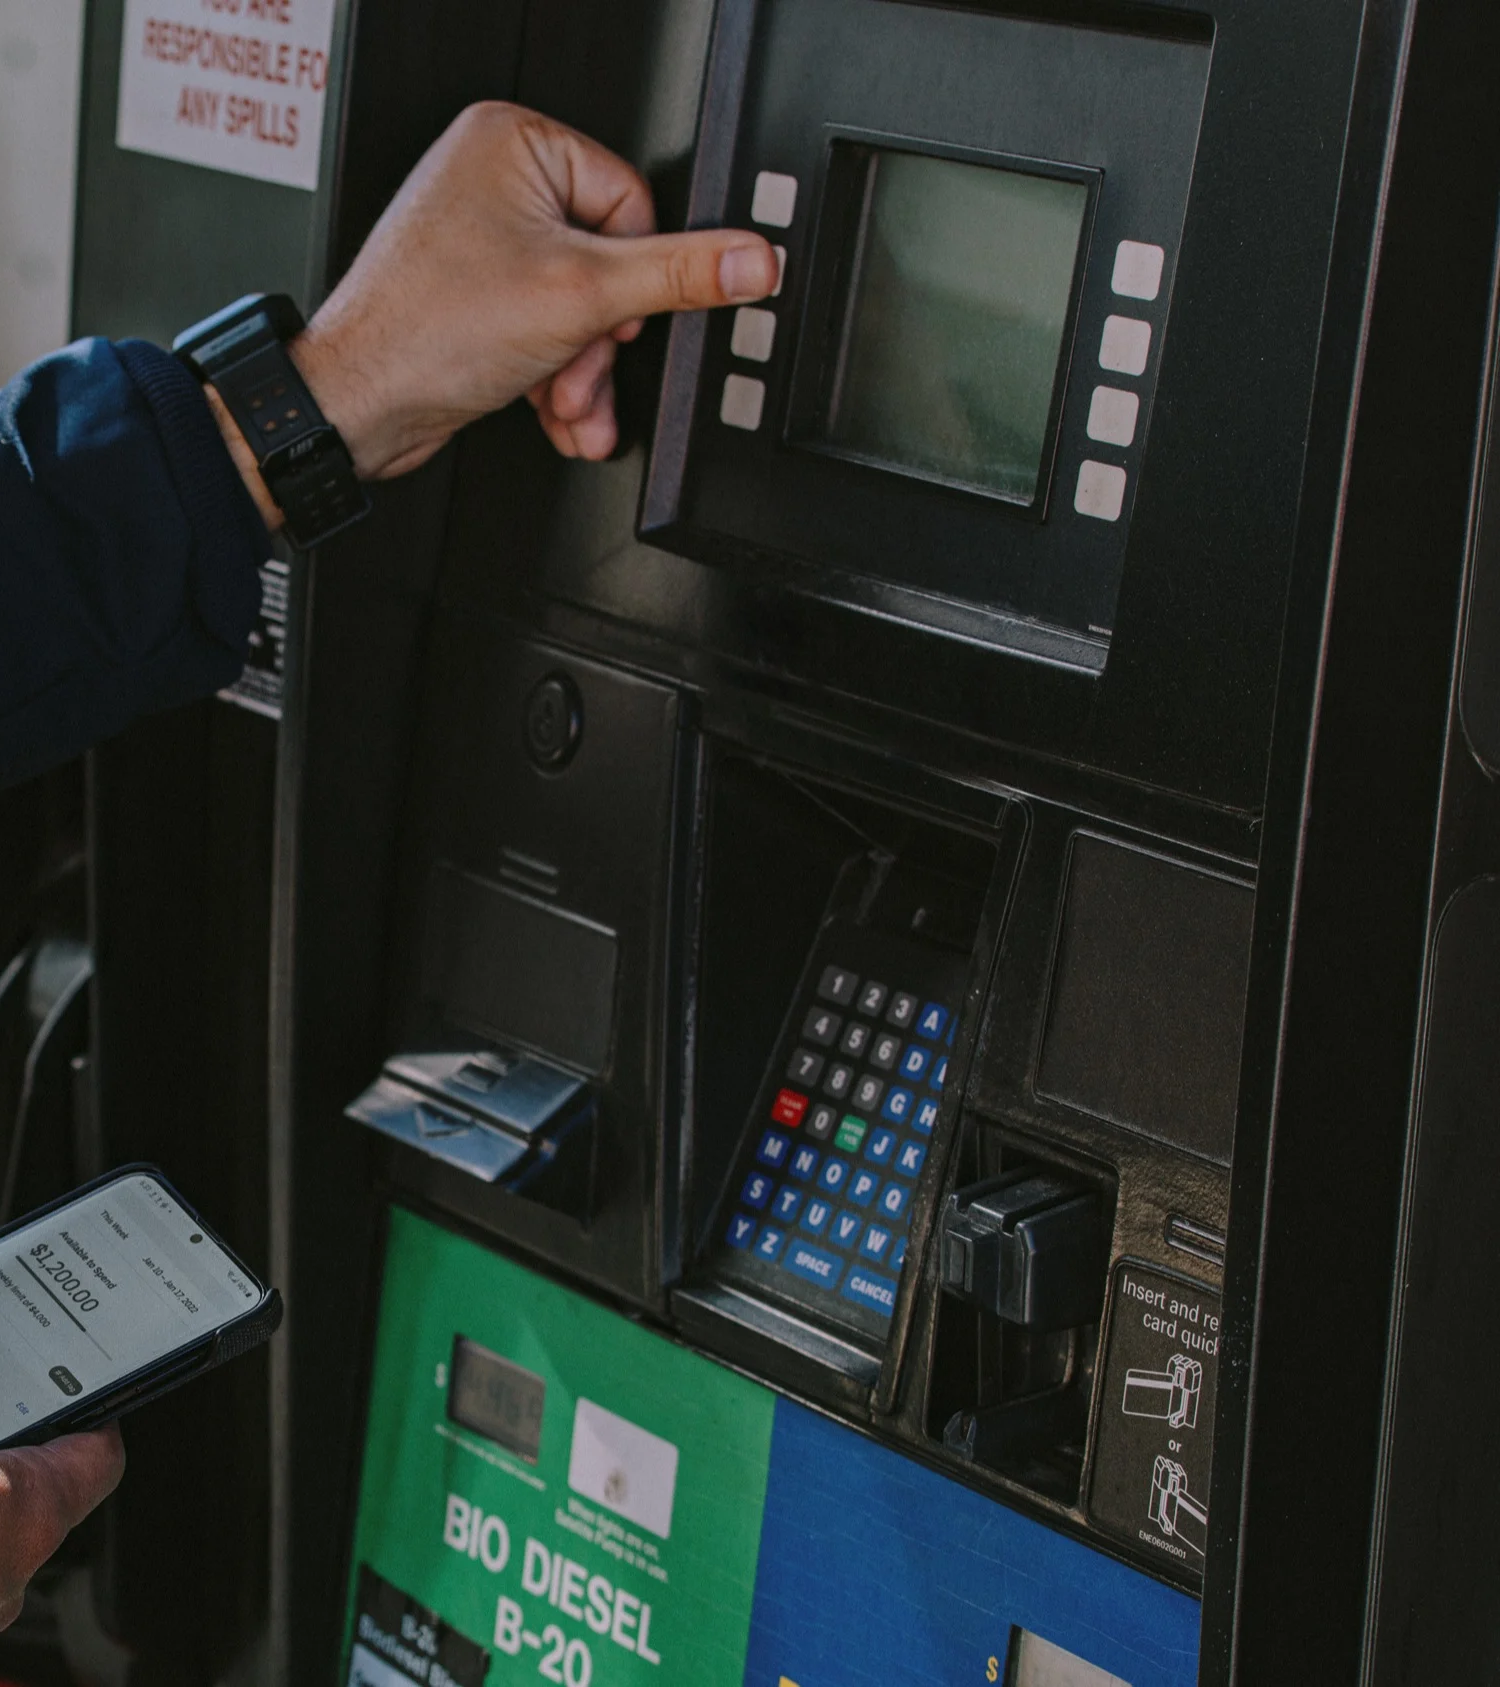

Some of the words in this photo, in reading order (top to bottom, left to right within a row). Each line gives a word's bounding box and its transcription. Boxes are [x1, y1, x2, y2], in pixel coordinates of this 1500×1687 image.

[143, 18, 290, 85] RESPONSIBLE
[176, 84, 220, 131] ANY
[225, 94, 299, 150] SPILLS
[832, 974, 844, 994] 1
[865, 988, 881, 1008] 2
[895, 999, 910, 1018] 3
[923, 1010, 939, 1032] A
[815, 1016, 830, 1035] 4
[849, 1029, 864, 1048] 5
[878, 1041, 893, 1061] 6
[906, 1051, 923, 1072] D
[799, 1056, 814, 1075] 7
[831, 1070, 847, 1090] 8
[861, 1081, 876, 1101] 9
[890, 1093, 907, 1114] G
[919, 1104, 937, 1127] H
[815, 1110, 829, 1130] 0
[764, 1137, 784, 1160] M
[796, 1150, 814, 1173] N
[825, 1163, 842, 1185] O
[855, 1175, 872, 1196] P
[885, 1189, 902, 1212] Q
[873, 1136, 890, 1156] J
[901, 1145, 920, 1170] K
[100, 1209, 114, 1226] This
[112, 1219, 129, 1241] Week
[749, 1179, 765, 1200] S
[780, 1191, 796, 1212] T
[808, 1204, 826, 1226] U
[839, 1216, 855, 1239] V
[866, 1229, 887, 1253] W
[29, 1243, 99, 1312] $1,200.00
[59, 1231, 89, 1262] Available
[86, 1258, 96, 1269] to
[93, 1267, 118, 1290] Spend
[142, 1256, 156, 1271] Jan
[153, 1266, 164, 1278] 10
[163, 1278, 178, 1293] Jan
[181, 1298, 199, 1314] 2022
[736, 1219, 750, 1240] Y
[761, 1232, 779, 1254] Z
[795, 1250, 832, 1277] SPACE
[850, 1276, 893, 1306] CANCEL
[10, 1284, 28, 1302] limit
[22, 1299, 34, 1309] of
[28, 1305, 51, 1328] $4,000
[1123, 1274, 1166, 1310] Insert
[1169, 1300, 1199, 1323] and
[1203, 1313, 1219, 1331] re
[1143, 1313, 1177, 1339] card
[16, 1402, 29, 1415] Edit
[1168, 1439, 1182, 1453] or
[1139, 1530, 1187, 1560] ENE0602G001
[444, 1492, 510, 1574] BIO
[521, 1536, 661, 1666] DIESEL
[494, 1595, 592, 1687] B-20
[985, 1656, 999, 1683] $
